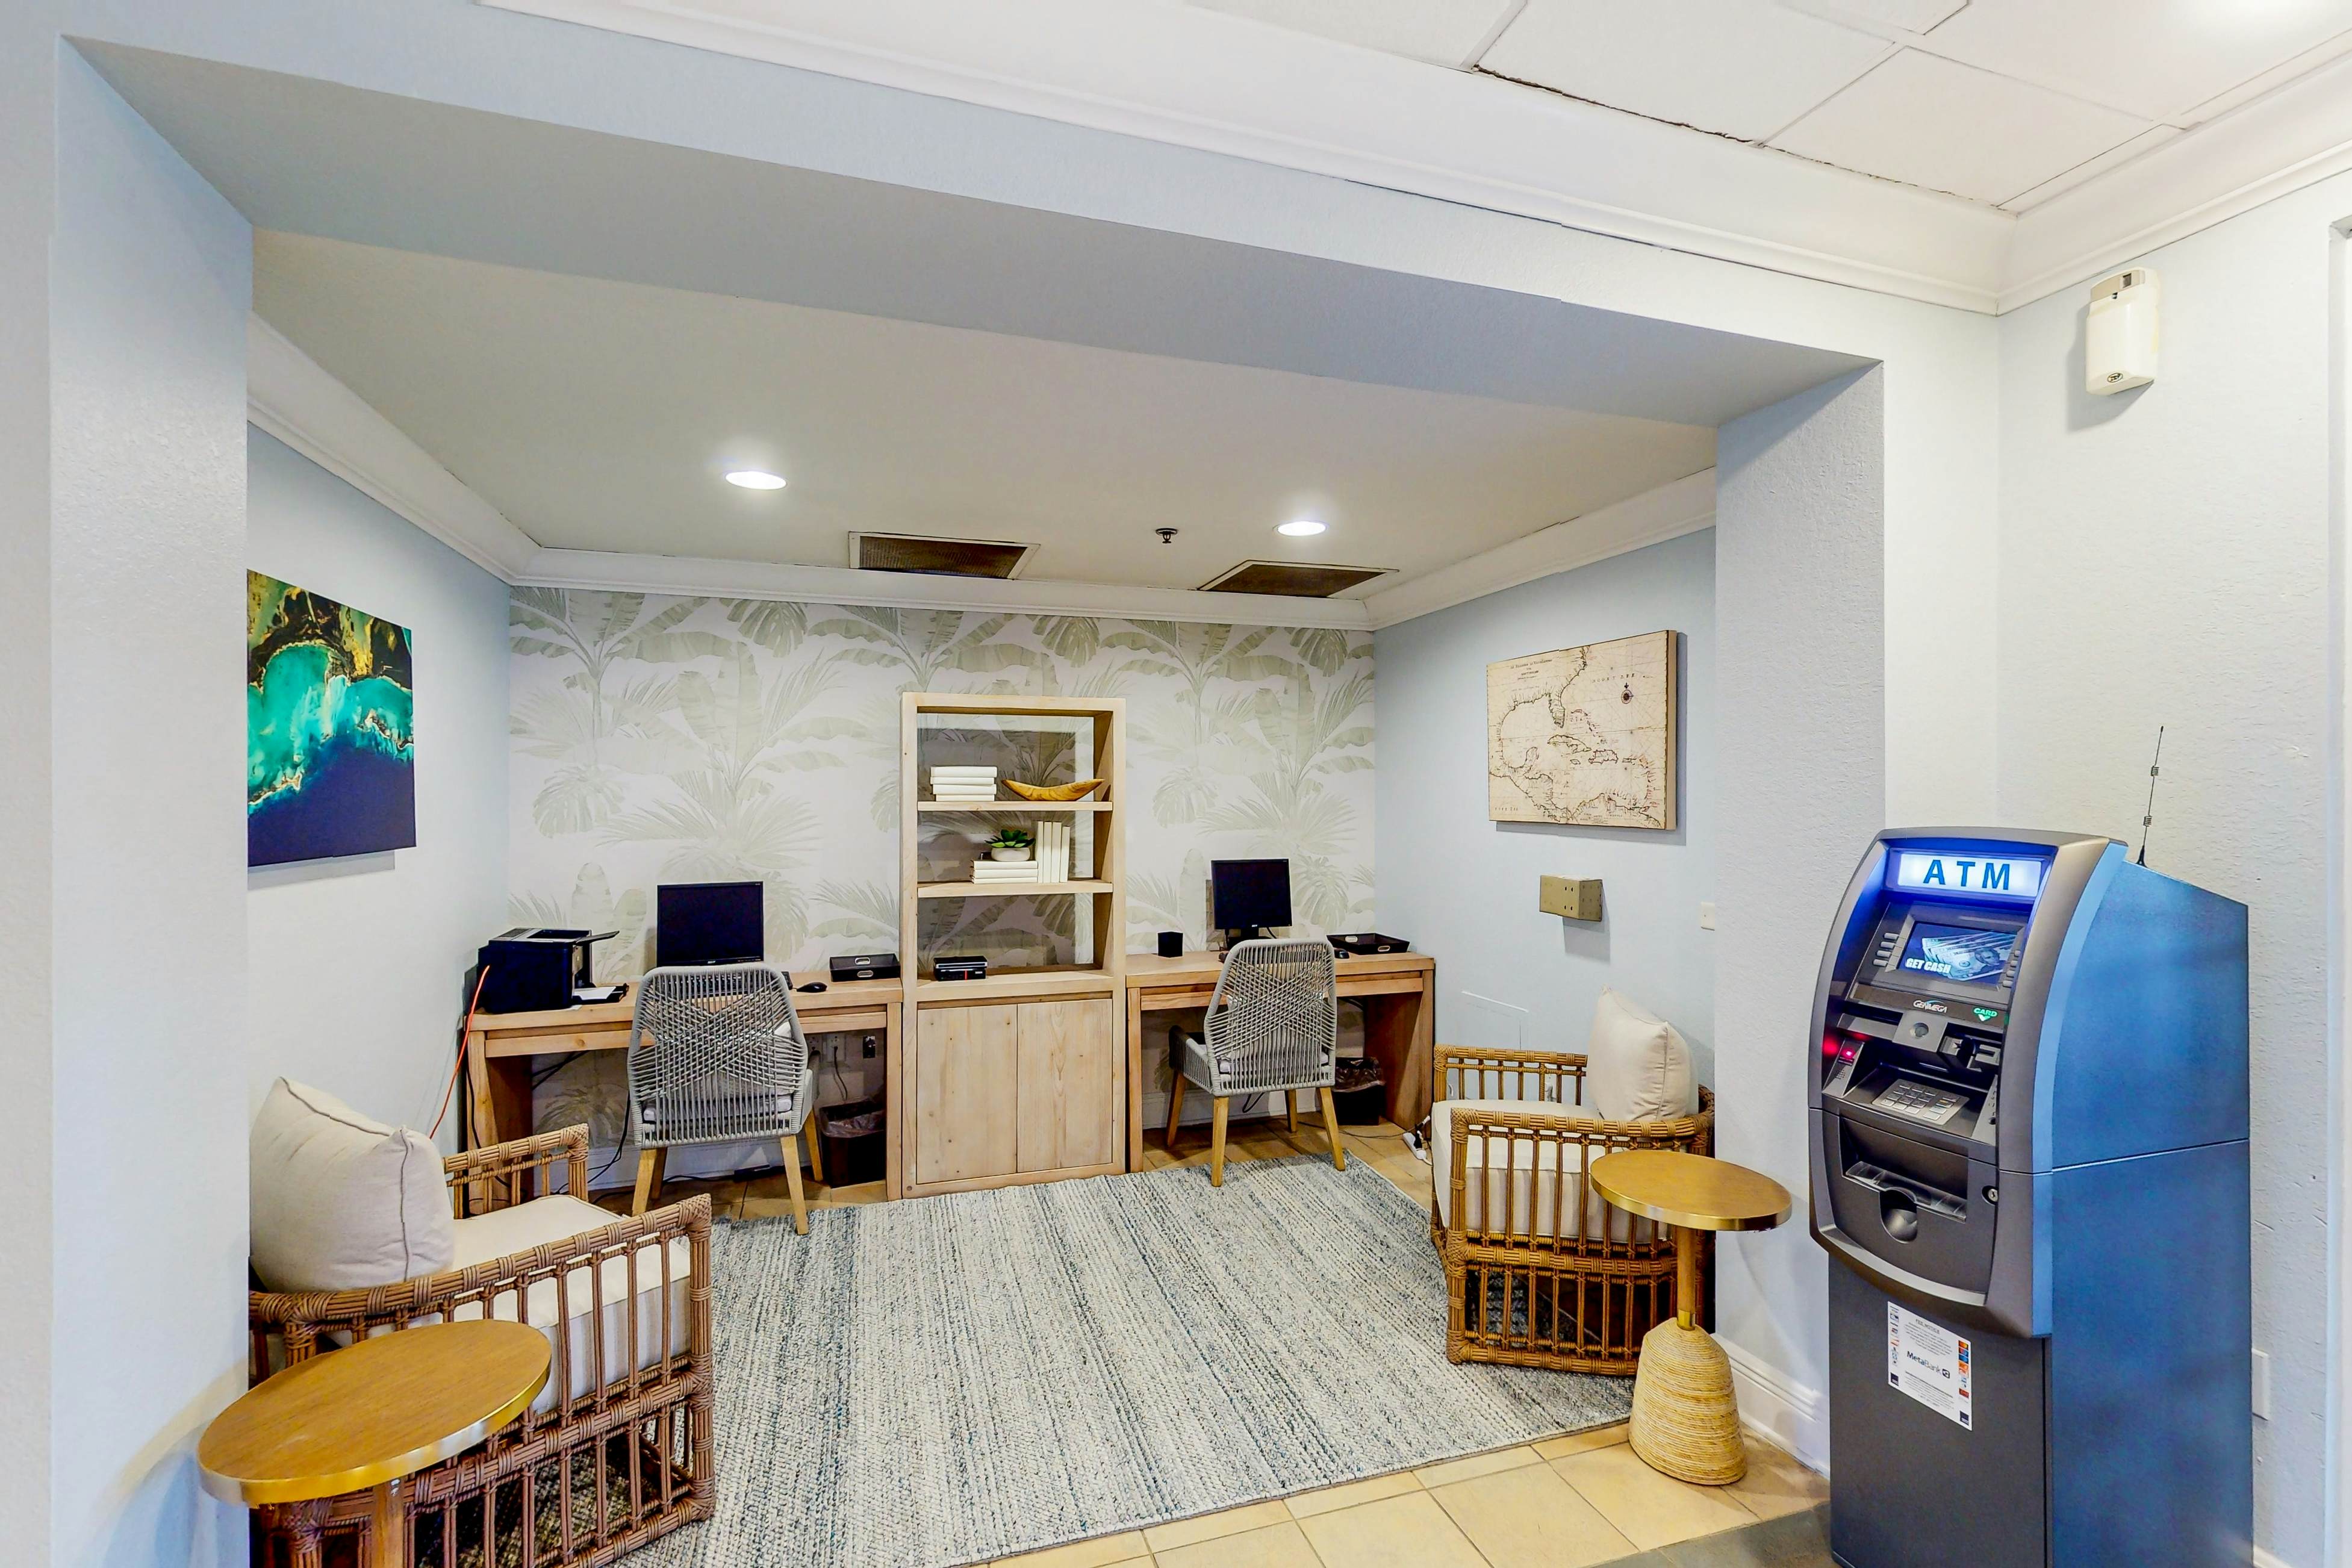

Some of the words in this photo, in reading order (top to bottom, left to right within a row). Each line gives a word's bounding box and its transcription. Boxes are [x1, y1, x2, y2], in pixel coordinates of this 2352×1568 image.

[1923, 859, 2010, 891] ATM
[1905, 958, 1925, 969] GET
[1924, 962, 1952, 974] CASH
[1974, 1008, 1997, 1017] CARD
[1907, 1351, 1942, 1375] MetaBank
